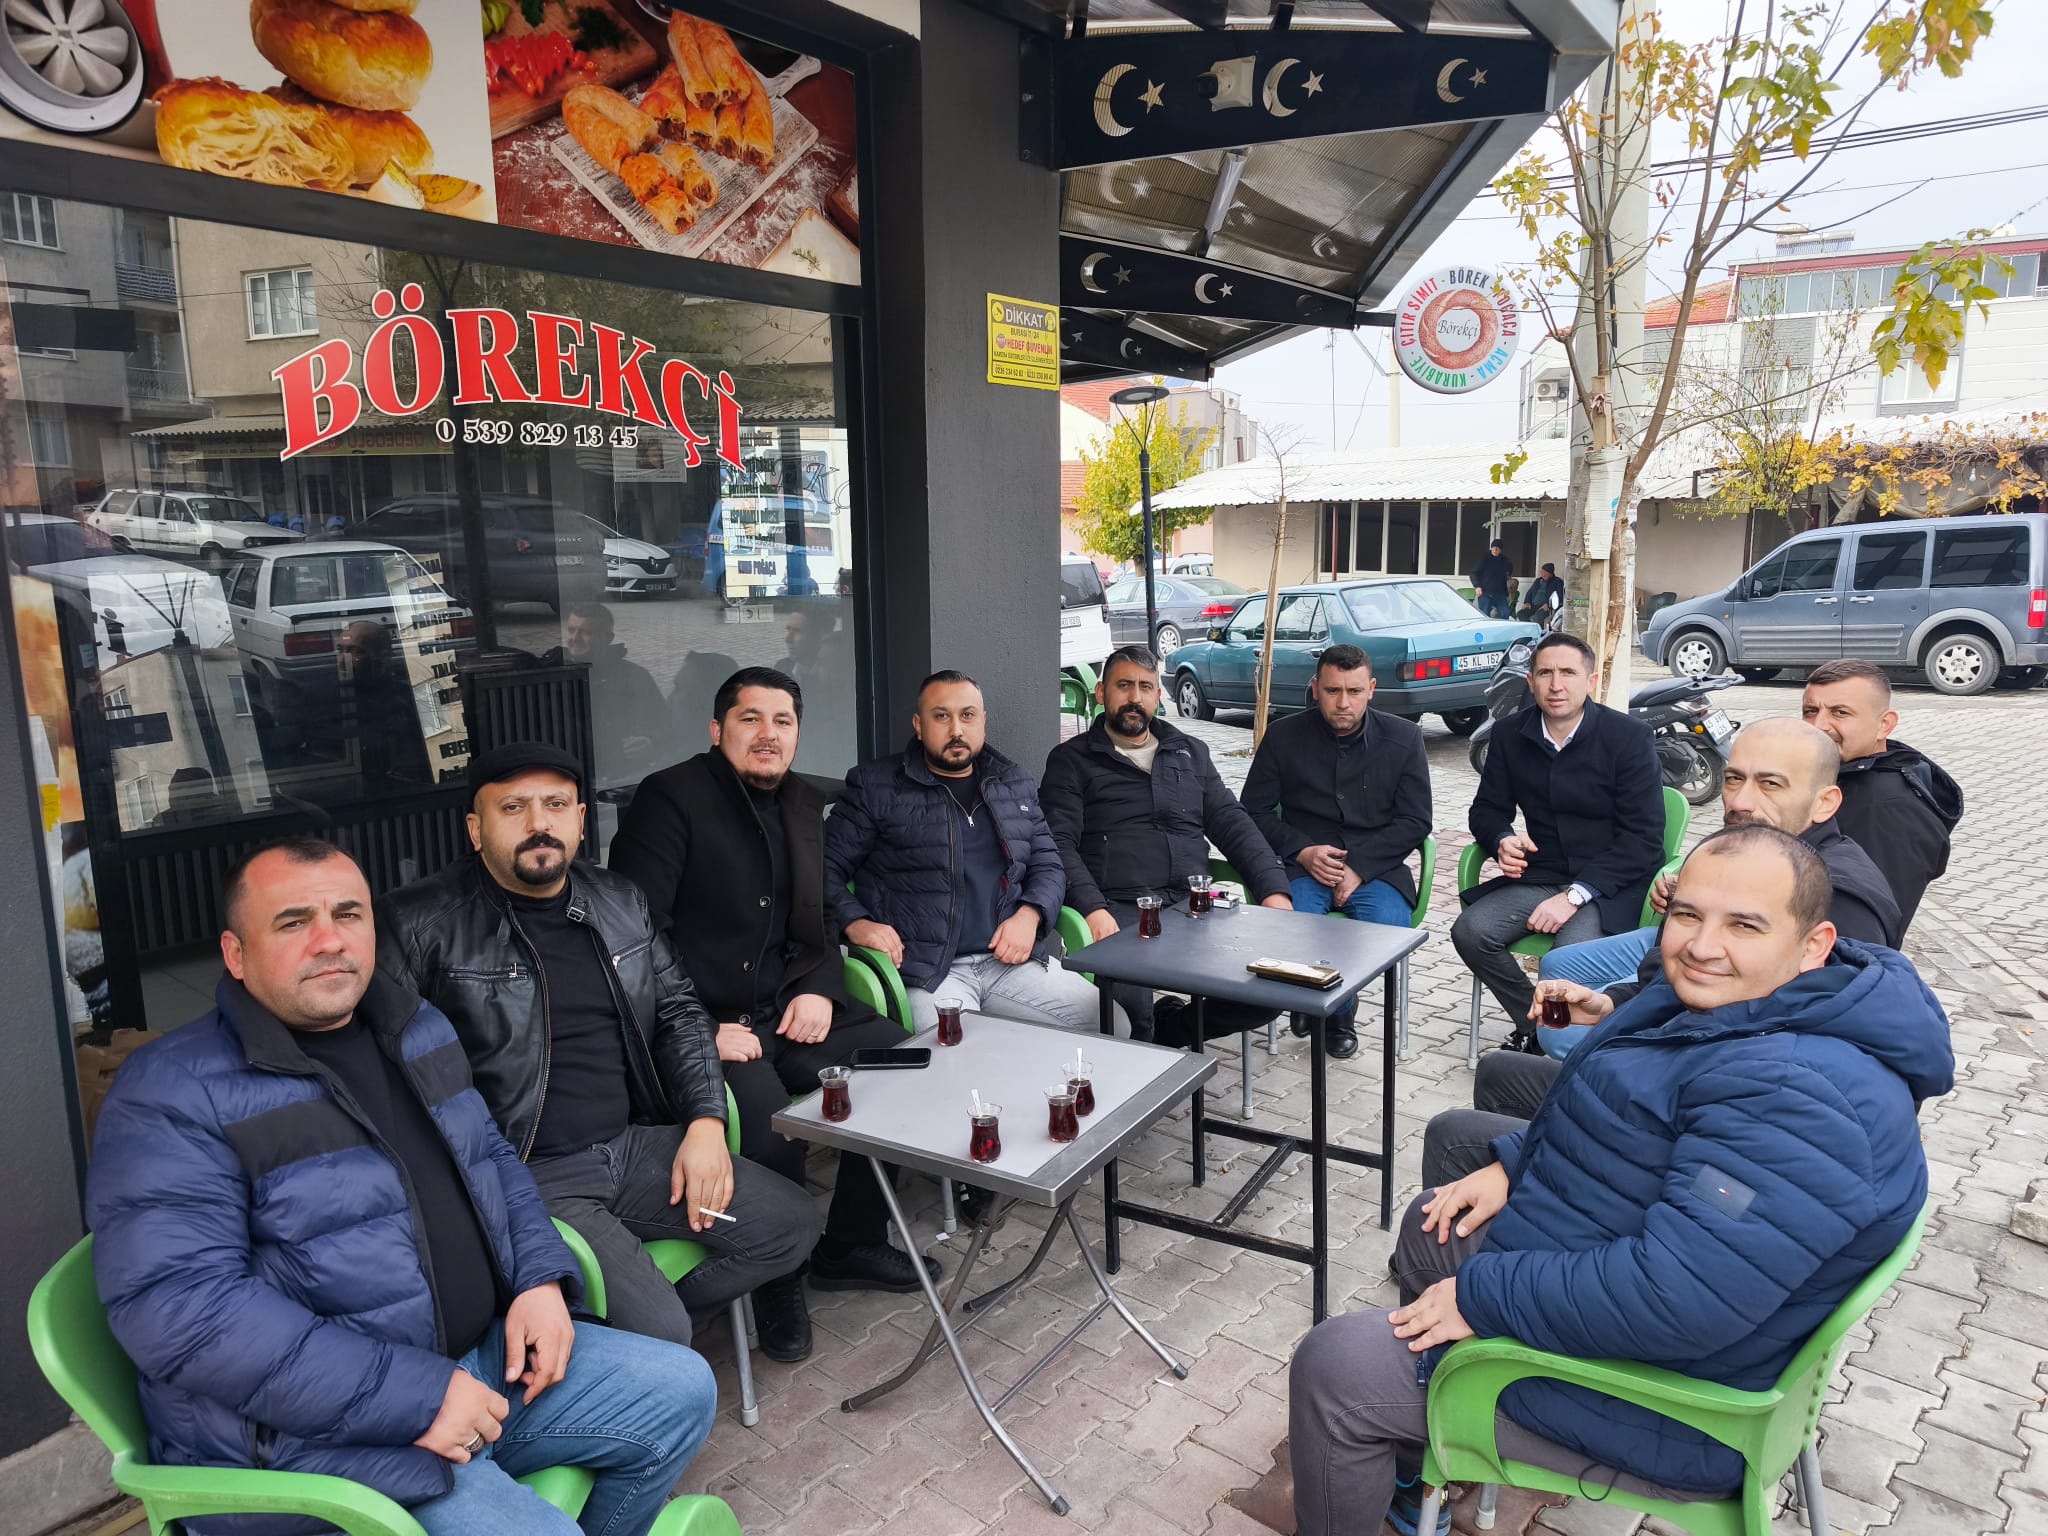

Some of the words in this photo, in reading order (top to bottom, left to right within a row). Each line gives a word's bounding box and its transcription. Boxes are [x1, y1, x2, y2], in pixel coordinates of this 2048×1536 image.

[1449, 267, 1490, 289] BÖREK
[1407, 277, 1439, 311] SİMİT
[1005, 306, 1044, 328] DİKKAT
[1399, 312, 1417, 347] ÇITIR
[1437, 319, 1480, 340] Börekçi
[1007, 338, 1025, 351] HEDEF
[270, 282, 746, 473] BÖREKÇİ
[1409, 355, 1467, 388] KURABİYE
[435, 417, 457, 443] 0
[463, 417, 514, 445] 539
[520, 421, 568, 447] 829
[574, 424, 604, 448] 13
[609, 426, 639, 449] 45
[1458, 656, 1469, 668] 45
[1472, 655, 1482, 667] KL
[1486, 653, 1500, 665] 162
